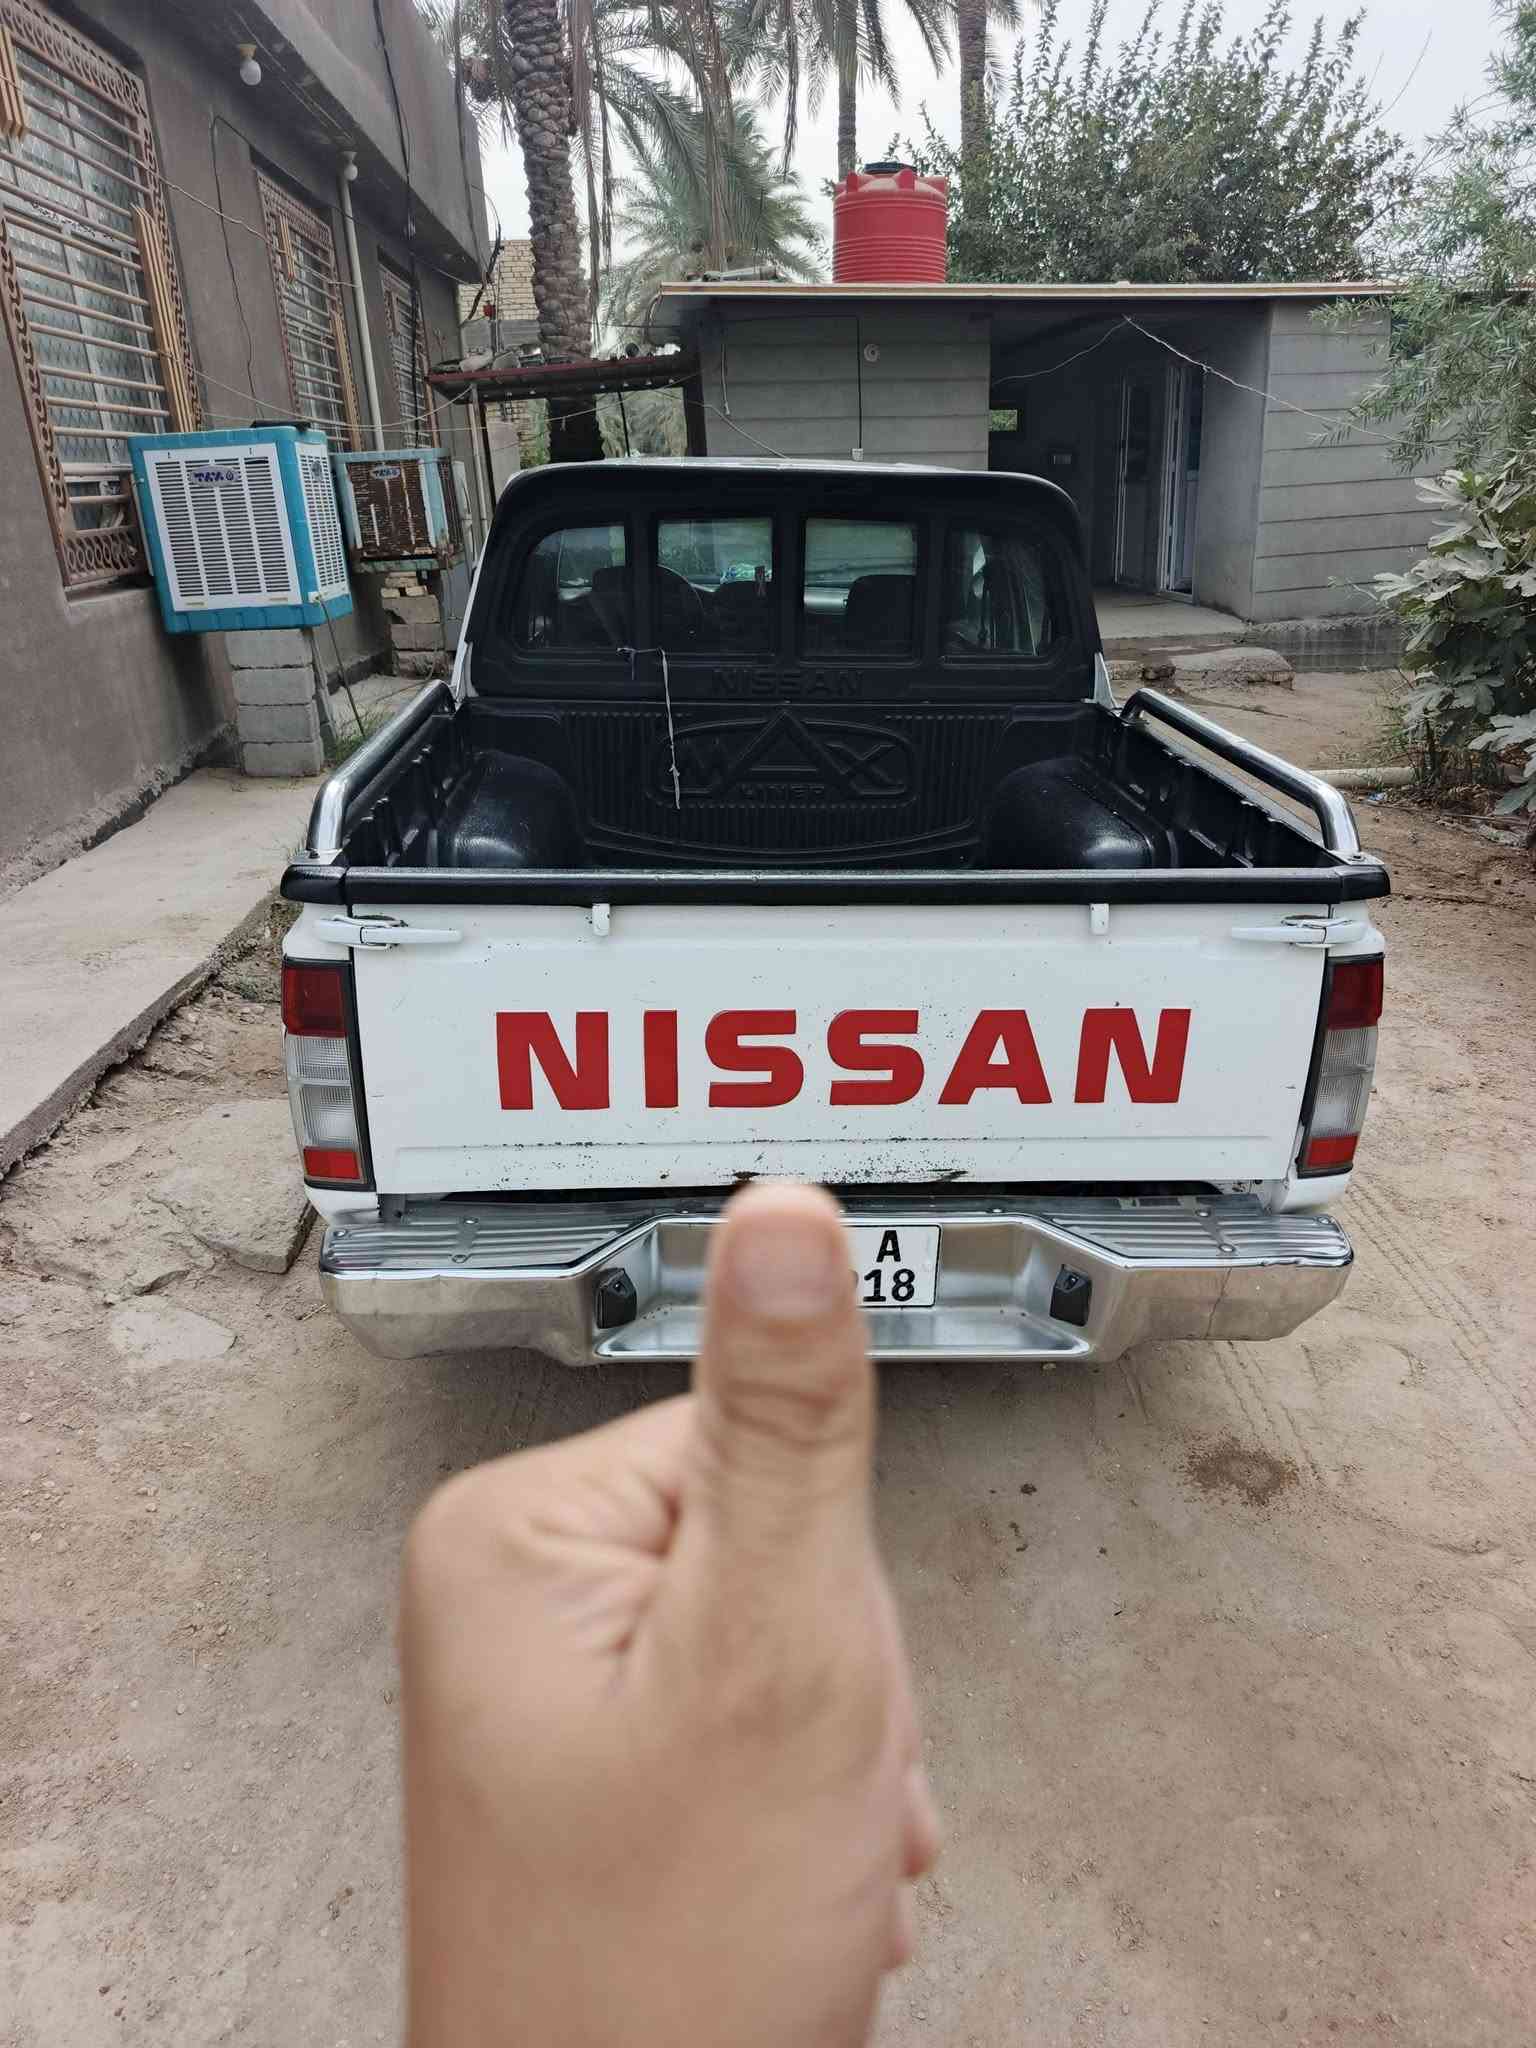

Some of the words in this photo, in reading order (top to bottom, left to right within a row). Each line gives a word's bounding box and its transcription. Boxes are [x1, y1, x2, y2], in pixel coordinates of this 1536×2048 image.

[713, 670, 863, 696] NISSAN
[496, 1008, 1191, 1110] NISSAN
[876, 1230, 901, 1262] A
[850, 1268, 915, 1302] 18
